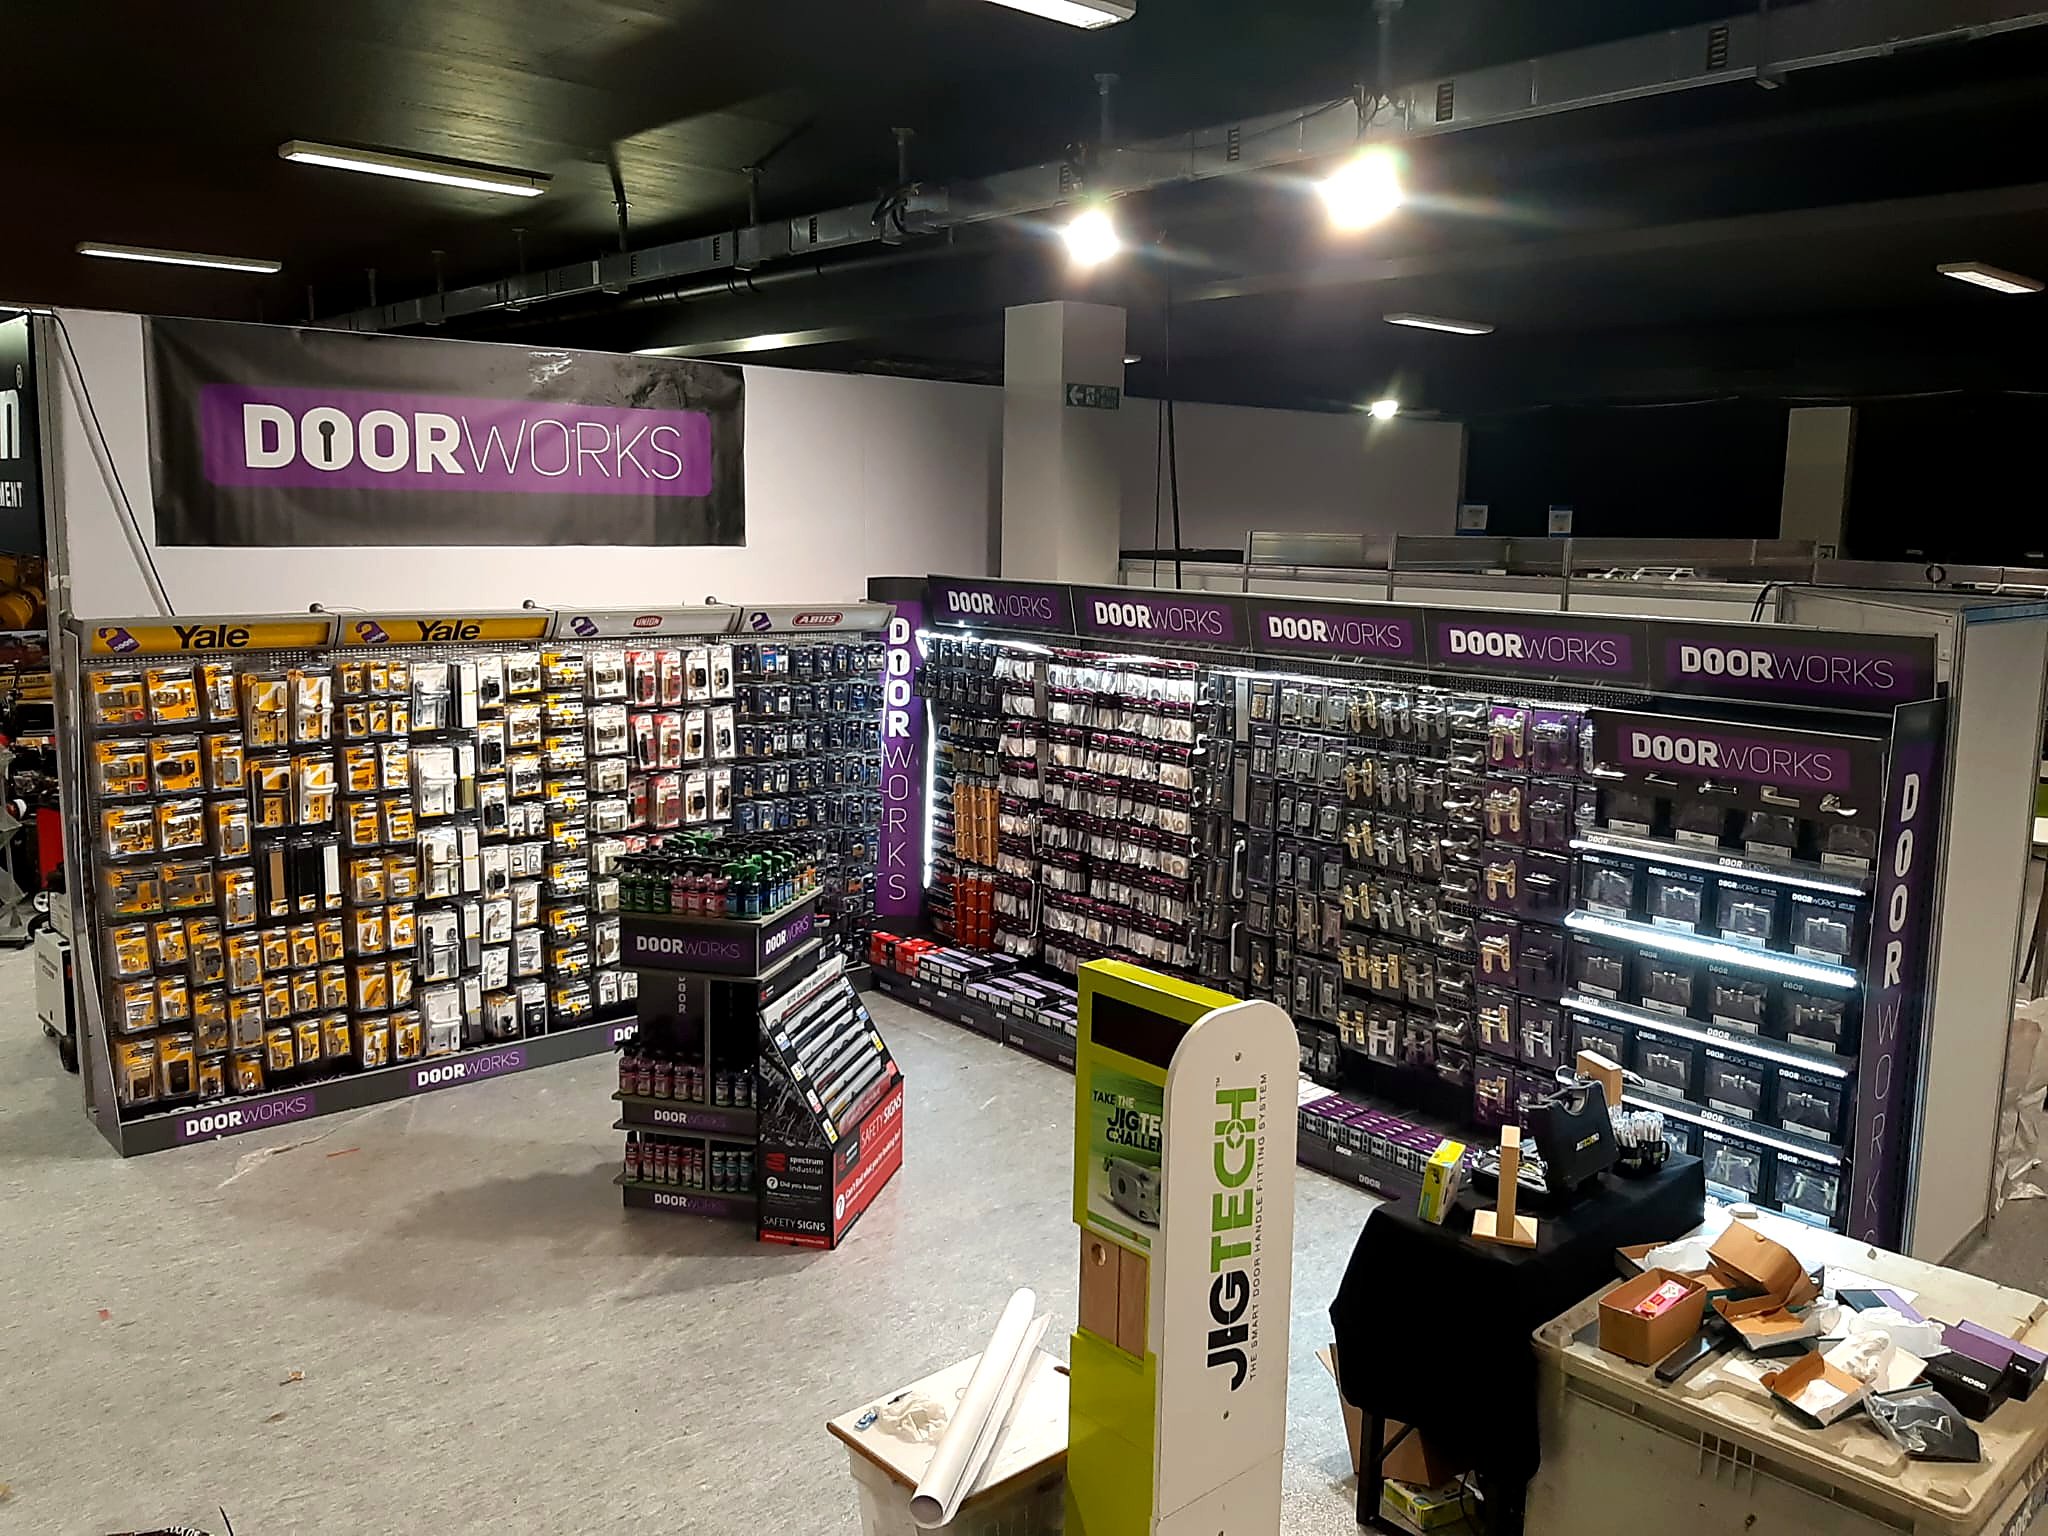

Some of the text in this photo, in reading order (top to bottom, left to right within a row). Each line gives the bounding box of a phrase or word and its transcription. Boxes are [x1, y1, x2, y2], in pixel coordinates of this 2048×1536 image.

[243, 403, 683, 481] DOORWORKS
[635, 618, 660, 627] UNION
[800, 615, 837, 625] ABUS
[948, 590, 1053, 620] DOORWORKS
[1095, 601, 1223, 635] DOORWORKS
[172, 624, 250, 649] Yale
[416, 620, 481, 642] Yale
[1268, 616, 1402, 648] DOORWORKS
[1449, 629, 1618, 667] DOORWORKS
[1680, 645, 1895, 690] DOORWORKS
[882, 617, 914, 901] DOORWORKS
[1631, 732, 1833, 782] DOORWORKS
[636, 935, 741, 960] DOORWORKS
[765, 914, 809, 956] DOORWORKS
[417, 1051, 520, 1088] DOORWORKS
[185, 1097, 307, 1137] DOORWORKS
[1093, 1090, 1136, 1109] TAKE THE
[861, 1115, 884, 1148] SAFETY
[883, 1092, 902, 1124] SIGNS
[763, 1216, 826, 1232] SAFETY SIGNS
[1206, 1087, 1257, 1392] JIGTECH
[1249, 1073, 1268, 1382] THE SMART DOOR HANDLE FITTING SYSTEM
